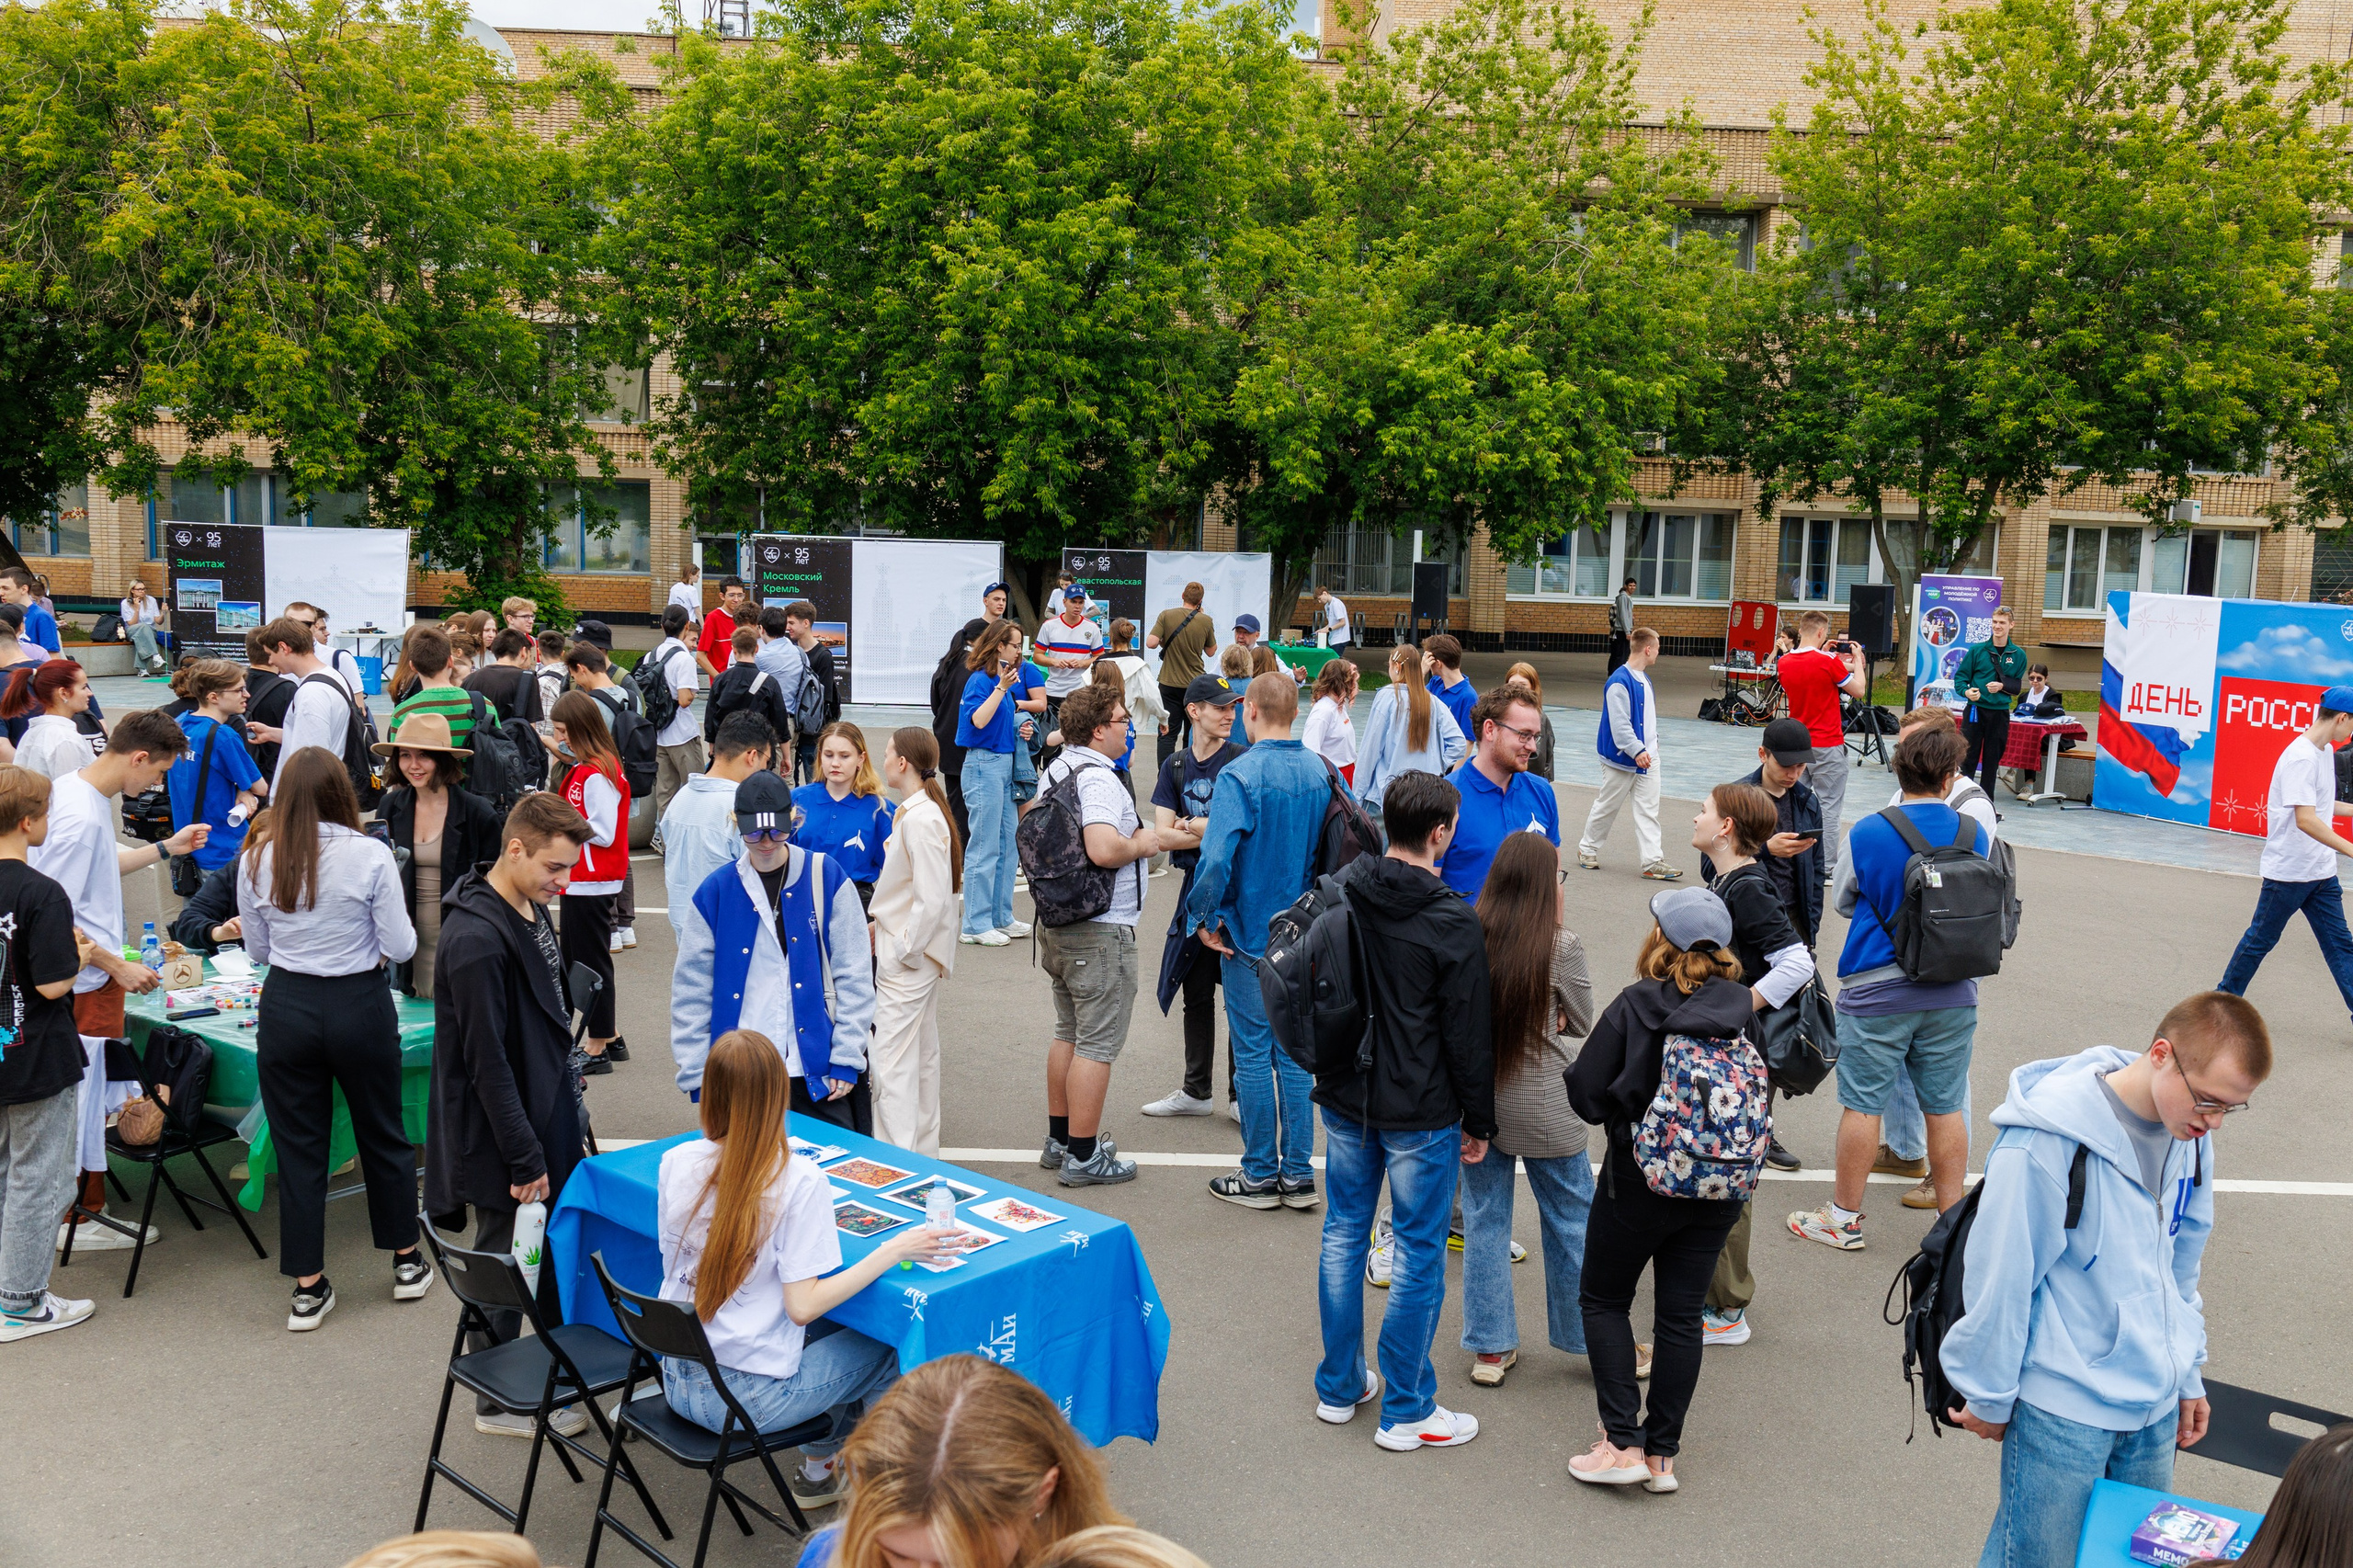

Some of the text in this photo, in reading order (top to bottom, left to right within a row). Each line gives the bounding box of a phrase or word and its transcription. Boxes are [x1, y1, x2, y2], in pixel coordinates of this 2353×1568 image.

[207, 532, 221, 542] 95
[795, 548, 809, 559] 95
[176, 558, 225, 569] Эрмитаж
[1097, 557, 1110, 566] 95
[763, 572, 823, 581] Московский
[1073, 576, 1142, 585] Севастопольская
[763, 584, 800, 594] Кремль
[2127, 682, 2202, 717] ДЕНЬ
[2225, 694, 2320, 733] РОСС
[990, 1312, 1017, 1365] МАИ
[2153, 1547, 2189, 1565] MEMO
